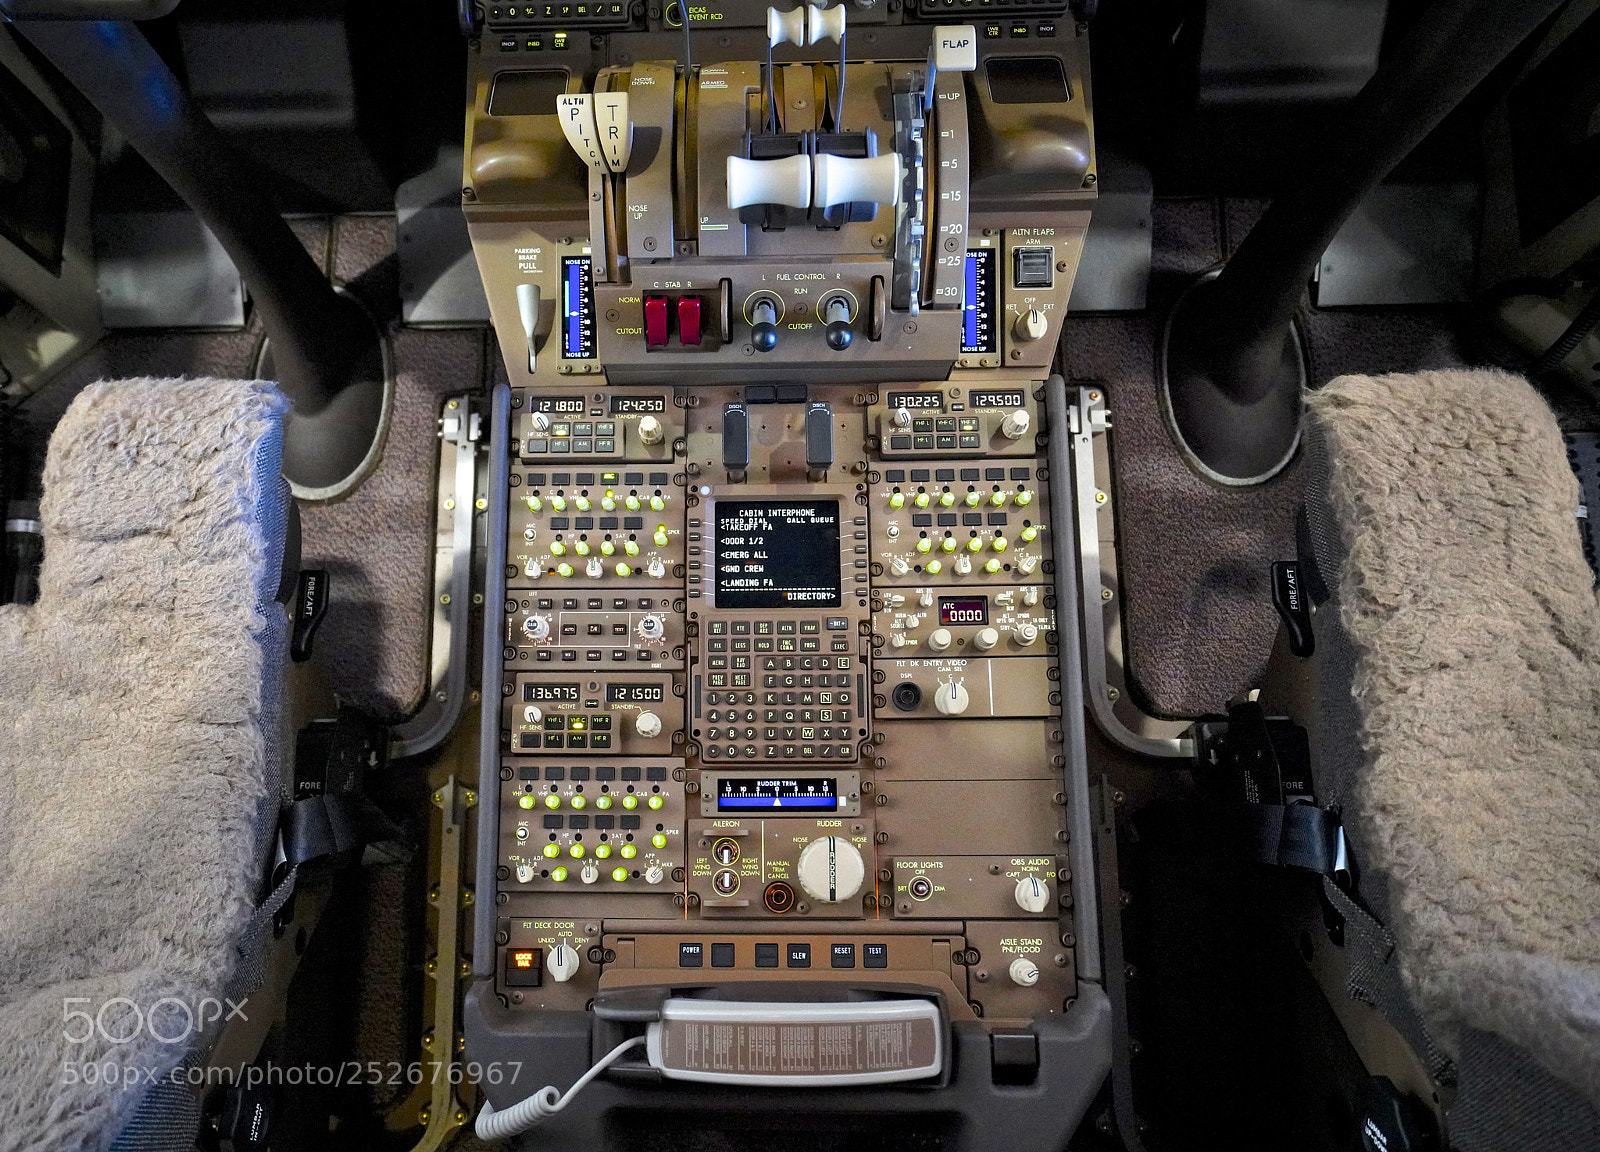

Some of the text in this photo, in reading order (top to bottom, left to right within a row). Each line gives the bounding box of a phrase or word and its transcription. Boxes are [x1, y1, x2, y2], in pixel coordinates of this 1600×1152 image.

[943, 40, 969, 48] FLAP
[563, 98, 584, 106] ALTN
[571, 108, 600, 166] PITCH
[607, 105, 620, 166] TRIM
[951, 160, 958, 168] 5
[950, 191, 961, 200] 15
[949, 224, 962, 233] 20
[947, 257, 960, 266] 25
[944, 287, 957, 296] 30
[894, 396, 939, 407] 130.225
[975, 395, 1021, 406] 129.500
[619, 401, 663, 411] 124.250
[739, 509, 815, 517] CABIN INTERPHONE
[754, 551, 768, 559] ALL
[1286, 568, 1298, 610] FORE/AFT
[306, 576, 316, 616] FORE/AFT
[950, 610, 982, 621] 0000
[532, 688, 578, 699] 136.975
[615, 688, 660, 699] 121.500
[792, 952, 806, 960] SLEW
